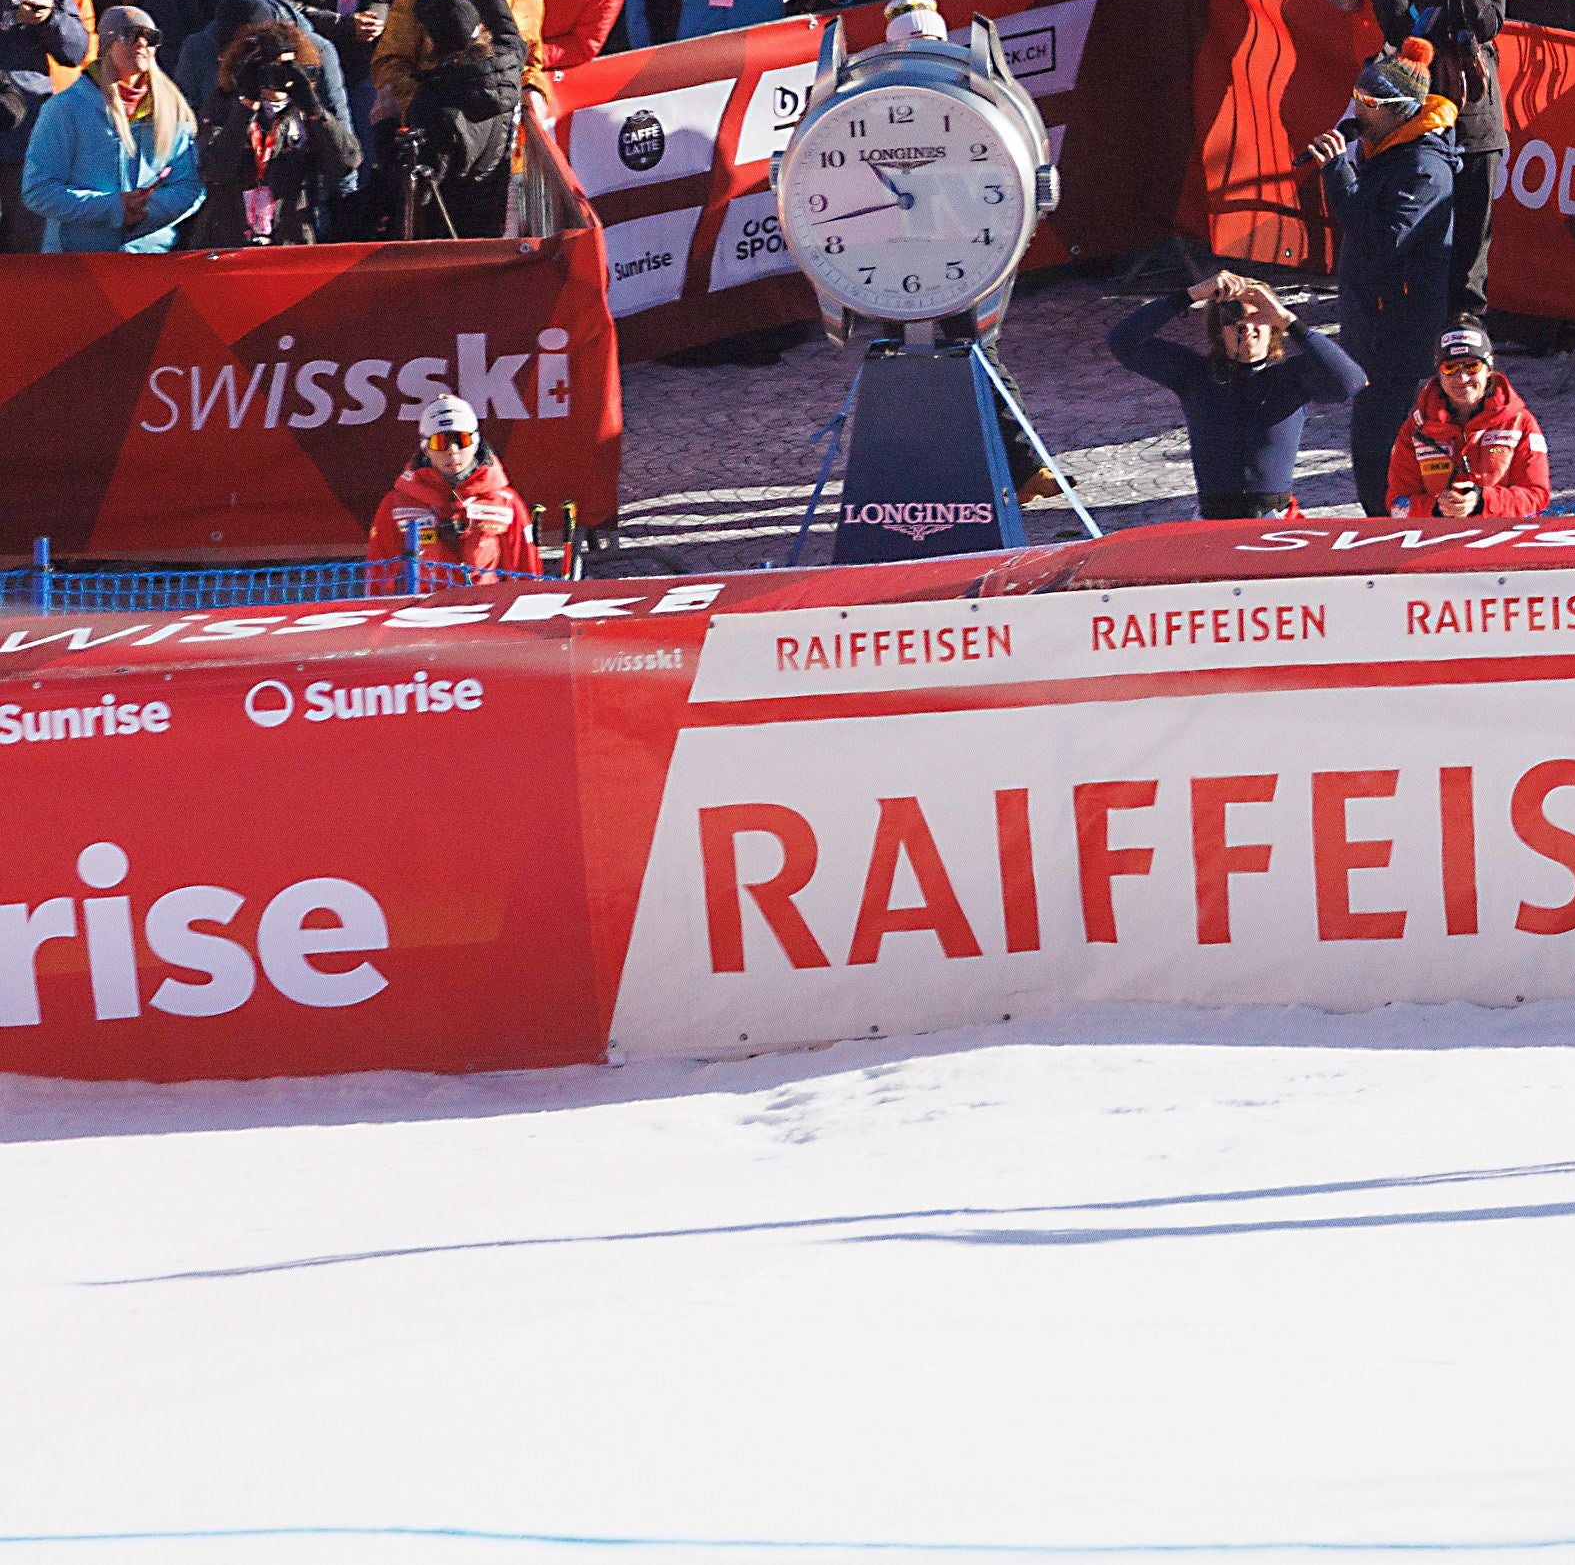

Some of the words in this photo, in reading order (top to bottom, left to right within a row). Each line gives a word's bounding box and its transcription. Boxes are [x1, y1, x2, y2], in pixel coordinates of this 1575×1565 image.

[887, 105, 914, 124] 12
[942, 115, 952, 133] 1
[849, 119, 867, 138] 11
[625, 139, 661, 156] LATTE
[858, 146, 947, 162] LONGINES
[969, 142, 988, 162] 2
[818, 149, 846, 169] 10
[808, 193, 829, 213] 9
[983, 185, 1004, 205] 3
[824, 235, 845, 255] 8
[971, 228, 994, 246] 4
[614, 251, 673, 282] Sunrise
[858, 266, 877, 285] 7
[945, 261, 965, 281] 5
[902, 274, 922, 294] 6
[140, 327, 570, 433] swissski
[844, 501, 994, 526] LONGINES
[1092, 605, 1326, 651] RAIFFEISEN
[775, 624, 1012, 671] RAIFFEISEN
[591, 646, 683, 674] swissski
[303, 670, 483, 722] Sunrise
